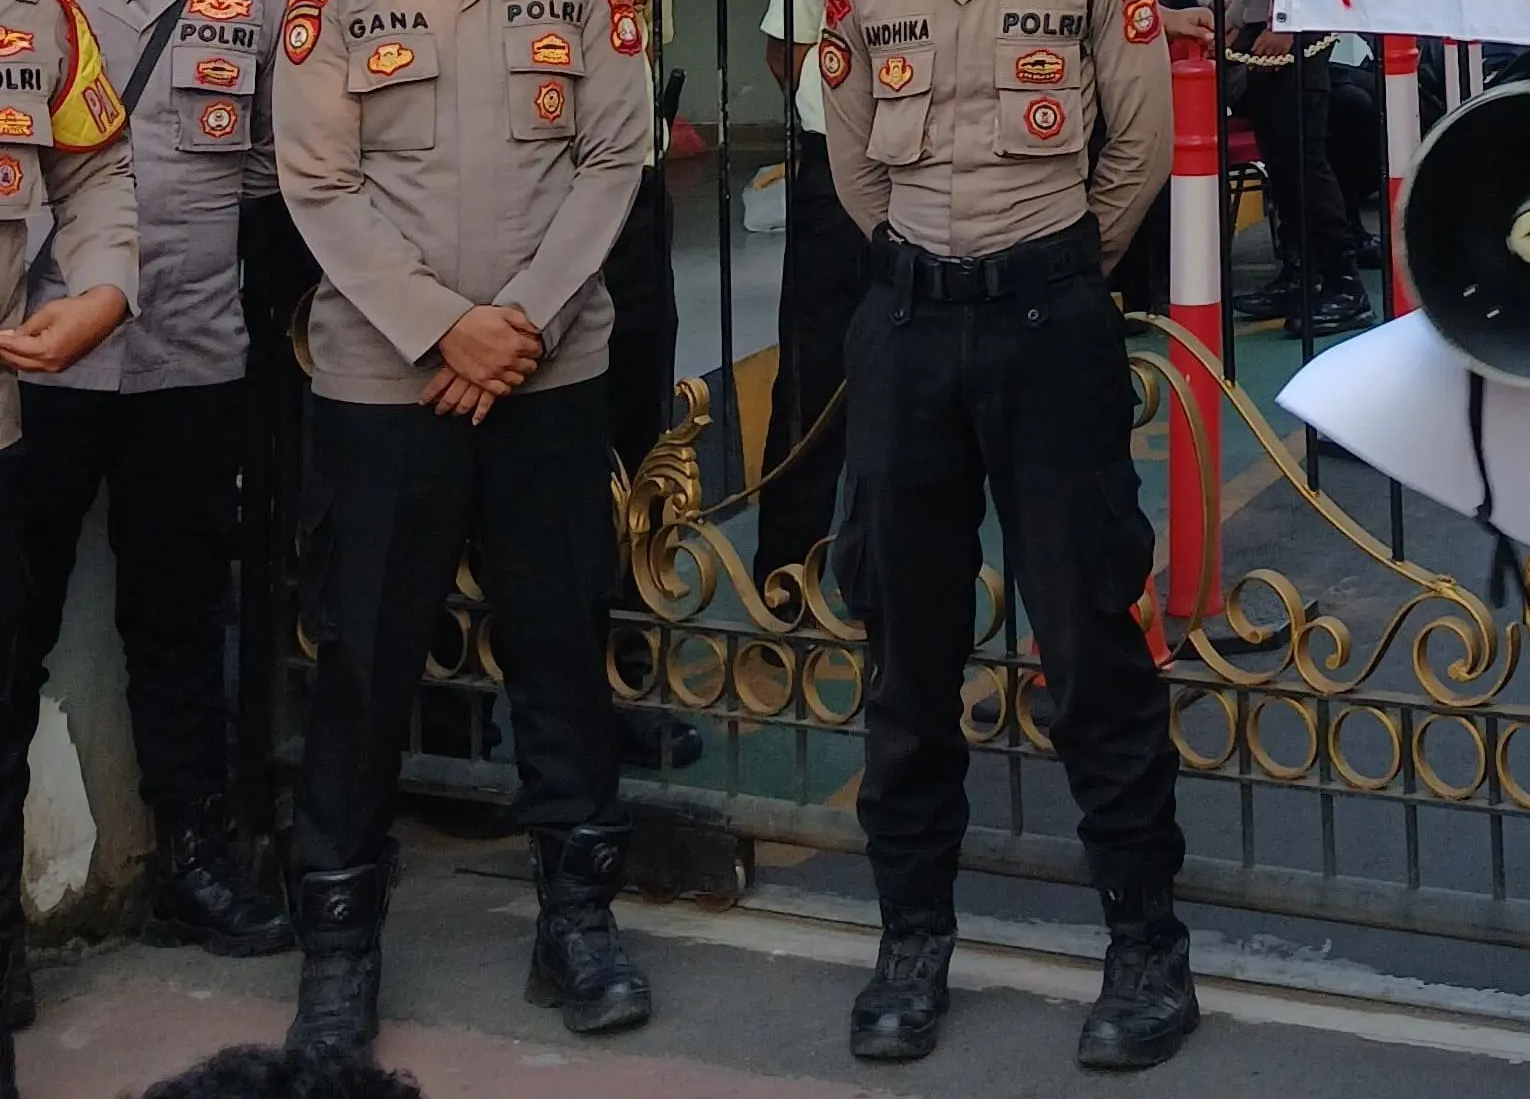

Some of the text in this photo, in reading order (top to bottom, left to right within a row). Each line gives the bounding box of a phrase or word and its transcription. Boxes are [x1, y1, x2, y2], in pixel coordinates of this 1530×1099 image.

[507, 0, 584, 23] POLRI
[1002, 12, 1084, 35] POLRI
[180, 23, 254, 48] POLRI
[349, 11, 429, 39] GANA
[865, 18, 929, 47] ANDHIKA
[0, 68, 42, 91] LRI
